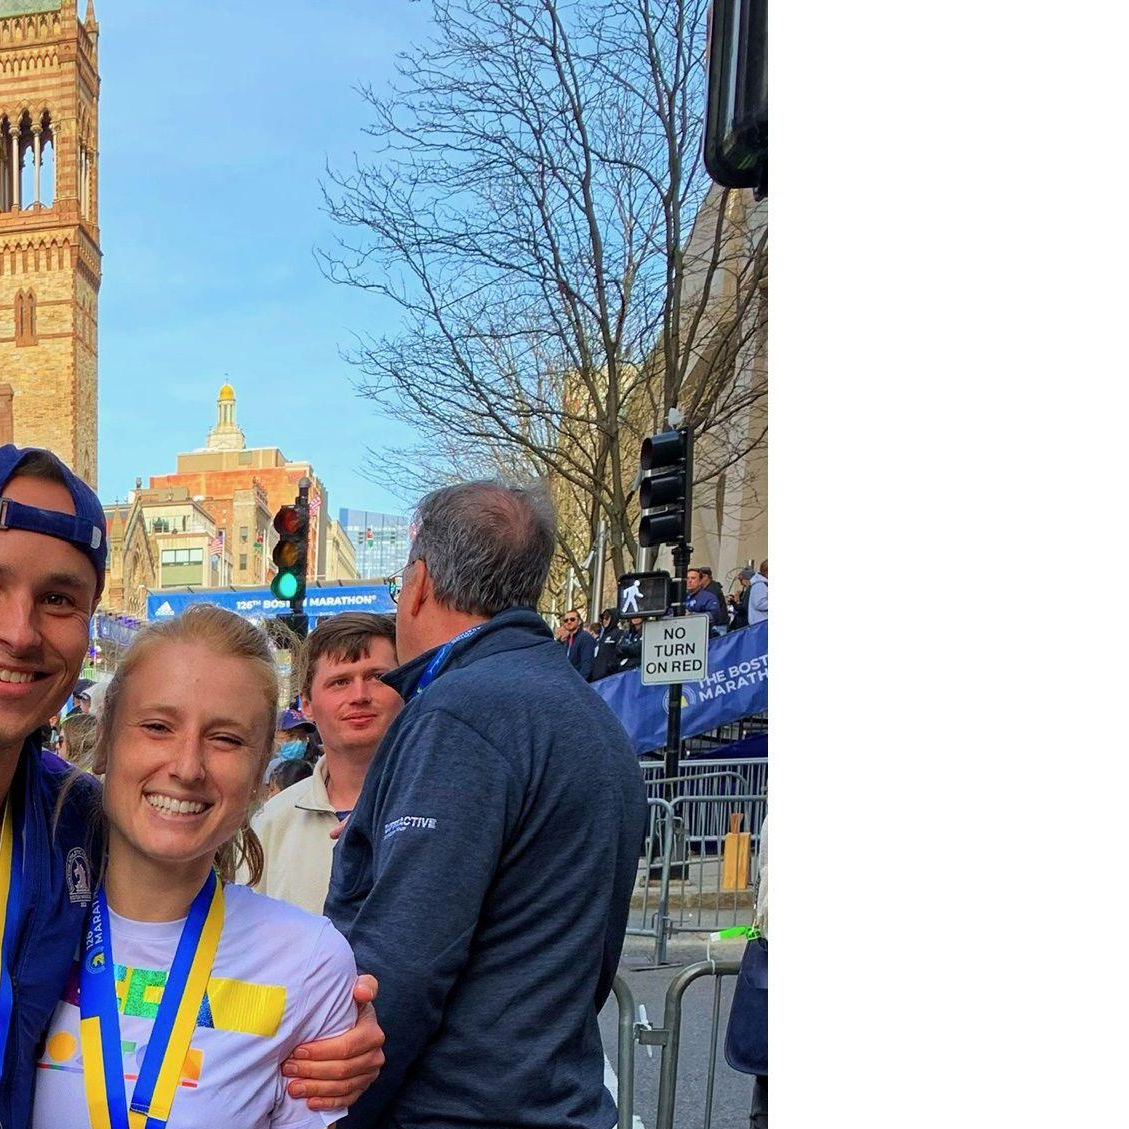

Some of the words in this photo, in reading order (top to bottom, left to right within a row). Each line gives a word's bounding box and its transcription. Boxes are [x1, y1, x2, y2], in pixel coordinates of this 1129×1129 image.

[664, 627, 686, 640] NO
[654, 643, 695, 658] TURN
[646, 662, 667, 674] ON
[671, 659, 703, 673] RED
[699, 670, 727, 689] THE
